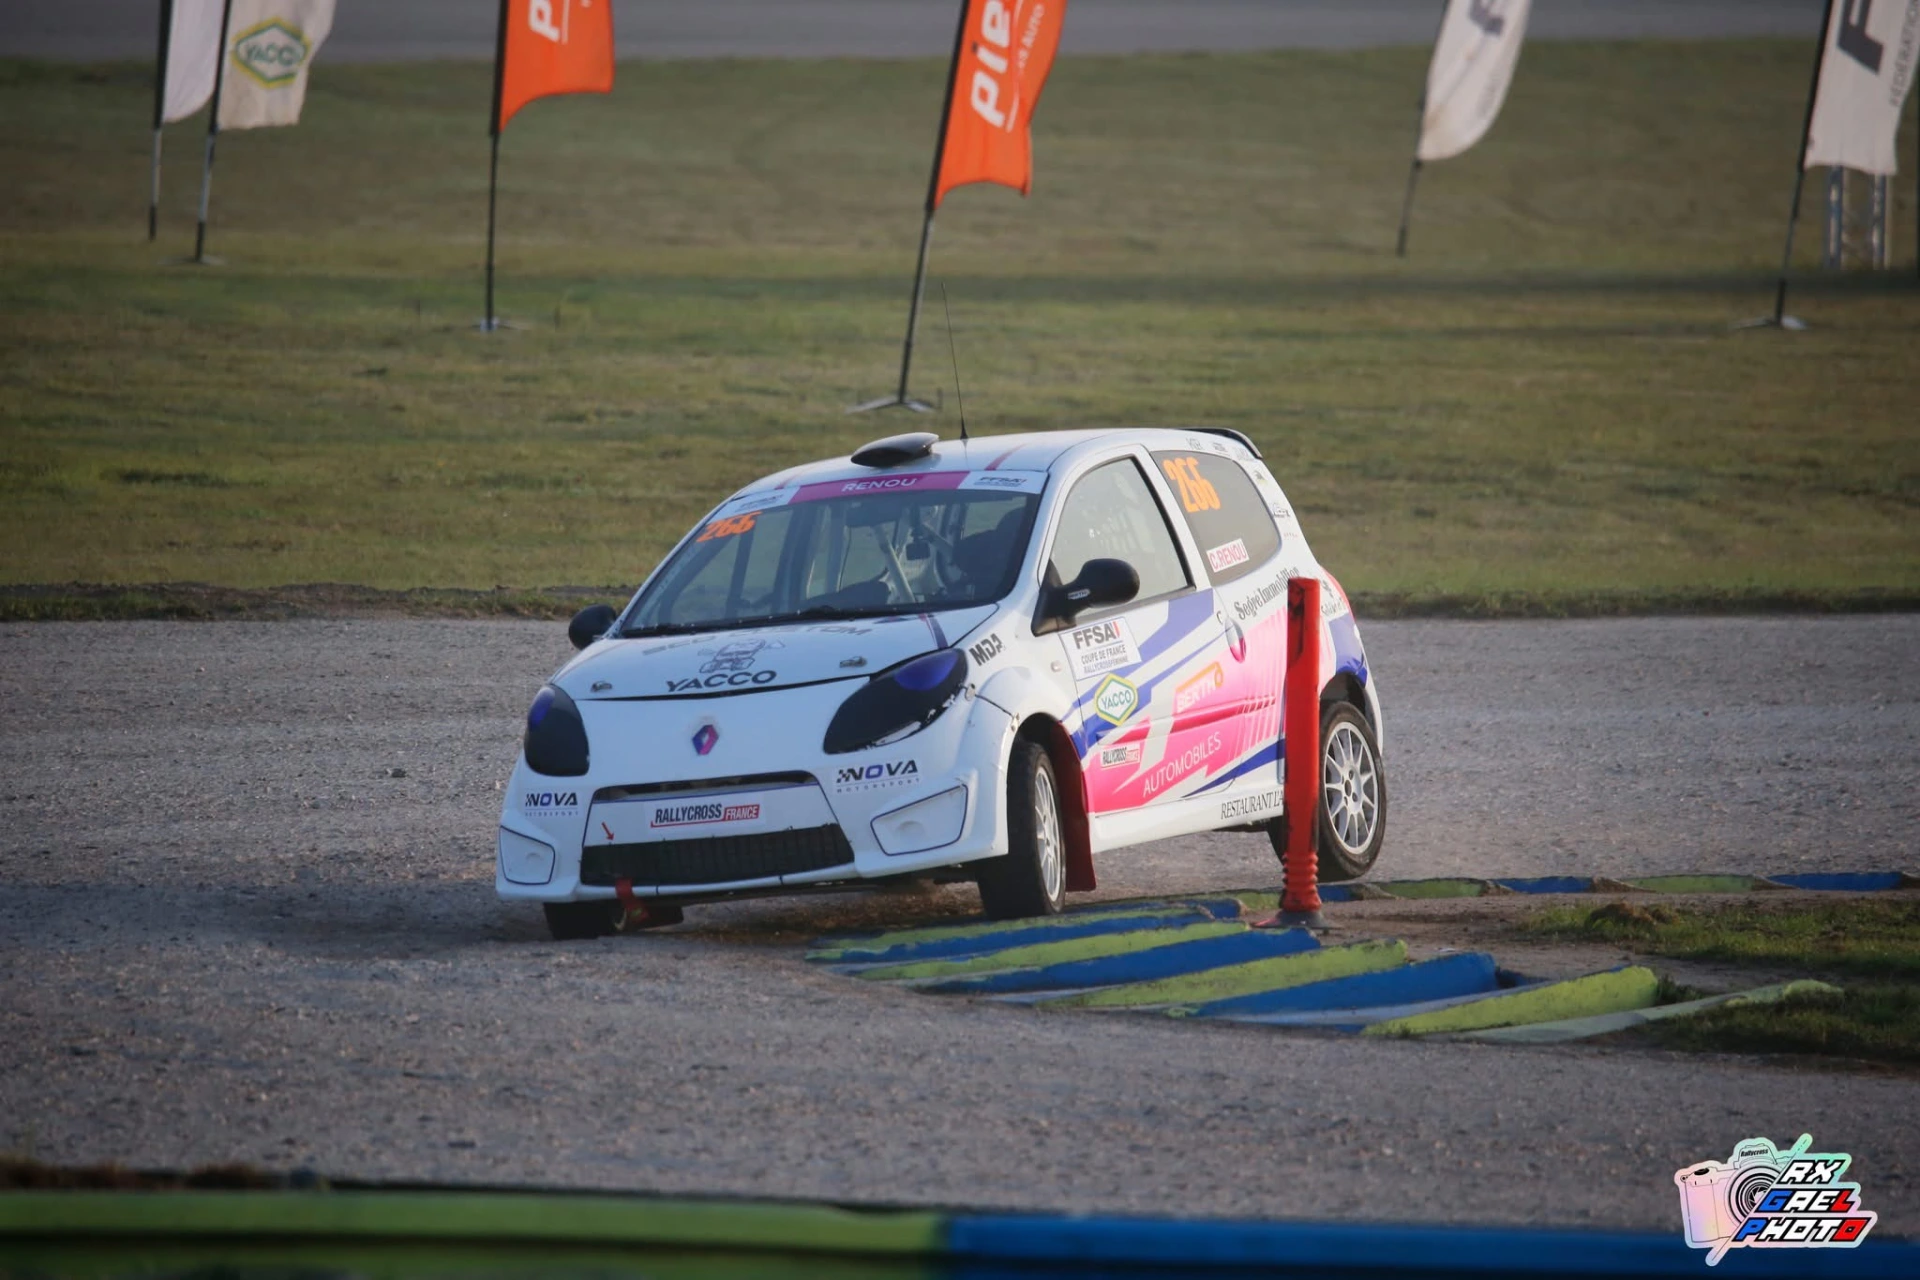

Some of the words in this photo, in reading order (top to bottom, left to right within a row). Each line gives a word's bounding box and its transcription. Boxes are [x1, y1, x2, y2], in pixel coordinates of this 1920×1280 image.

[841, 477, 919, 492] RENOU
[1162, 456, 1221, 513] 266
[696, 511, 762, 543] 266
[1209, 541, 1247, 570] C.RENOU
[1072, 622, 1118, 649] FFSA
[968, 632, 1004, 667] MDA
[1081, 651, 1099, 665] COUPE
[1106, 644, 1126, 658] FRANCE
[665, 670, 778, 693] YACCO
[1101, 688, 1132, 711] YACCO
[836, 759, 918, 784] NOVA
[1142, 732, 1222, 798] AUTOMOBILES
[525, 792, 578, 807] NOVA
[1220, 792, 1274, 820] RESTAURANT
[654, 803, 722, 824] RALLYCROSS
[725, 804, 759, 821] FRANCE
